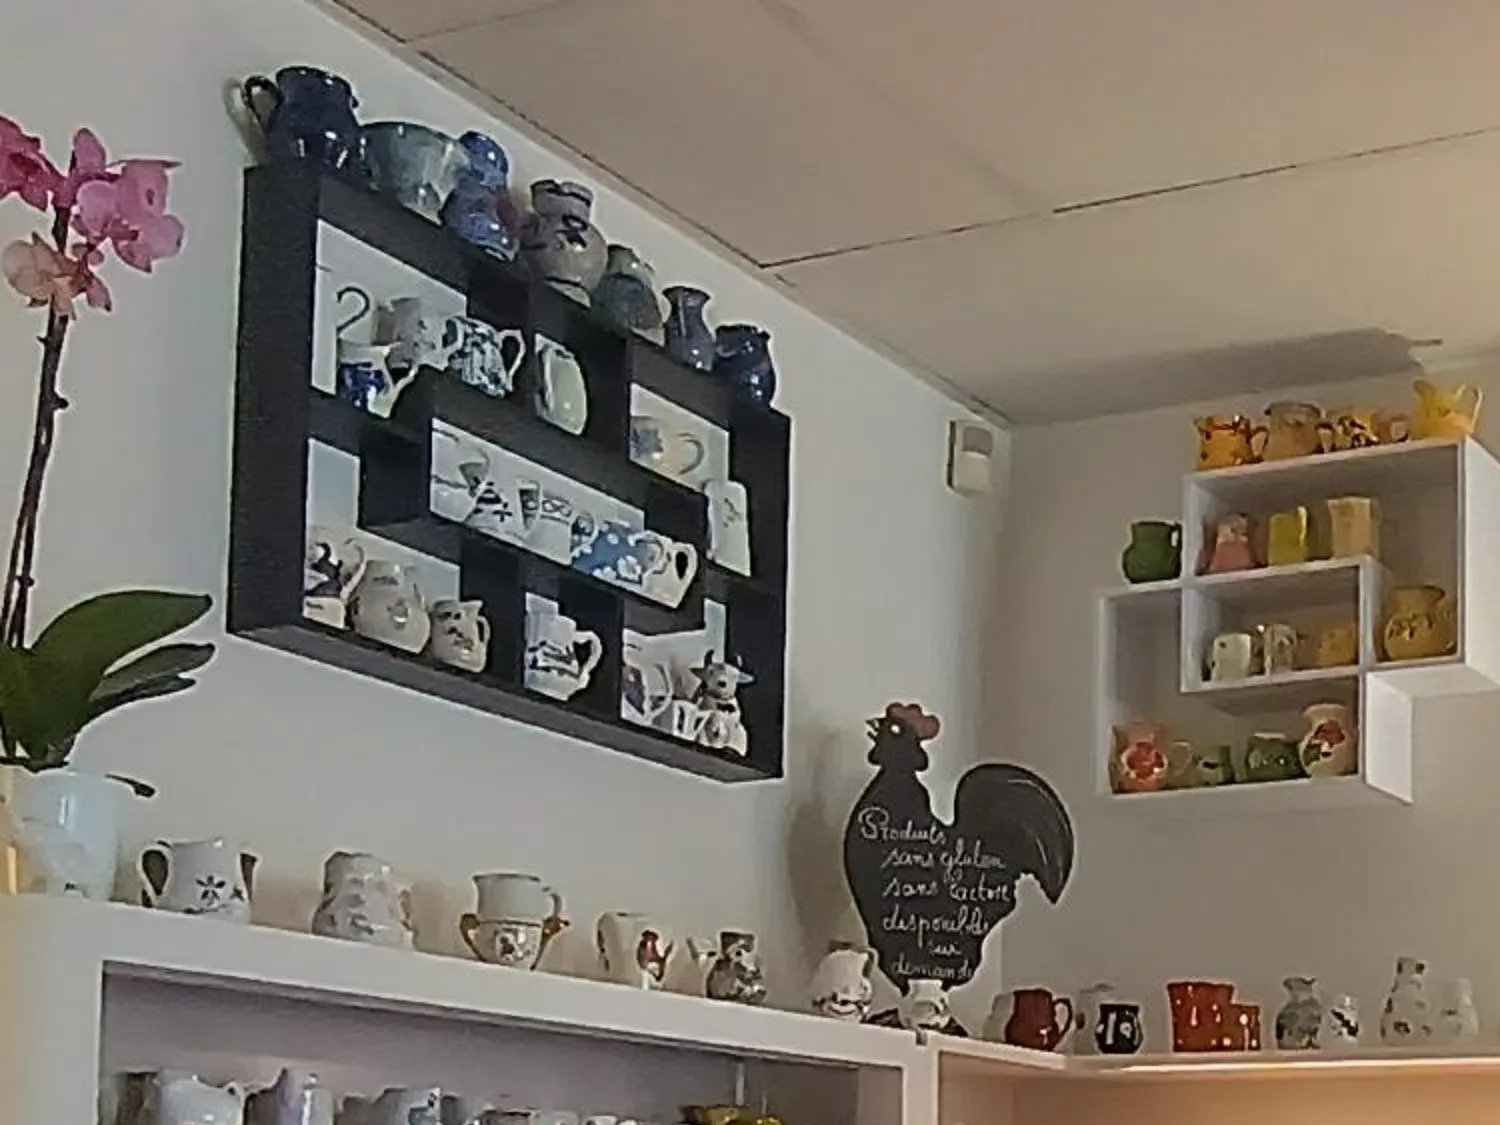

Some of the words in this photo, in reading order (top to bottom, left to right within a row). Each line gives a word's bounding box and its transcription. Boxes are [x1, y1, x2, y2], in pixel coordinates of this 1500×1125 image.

[858, 806, 946, 844] Produits
[880, 848, 935, 869] sans
[940, 837, 1006, 882] gluten
[882, 877, 939, 897] sans
